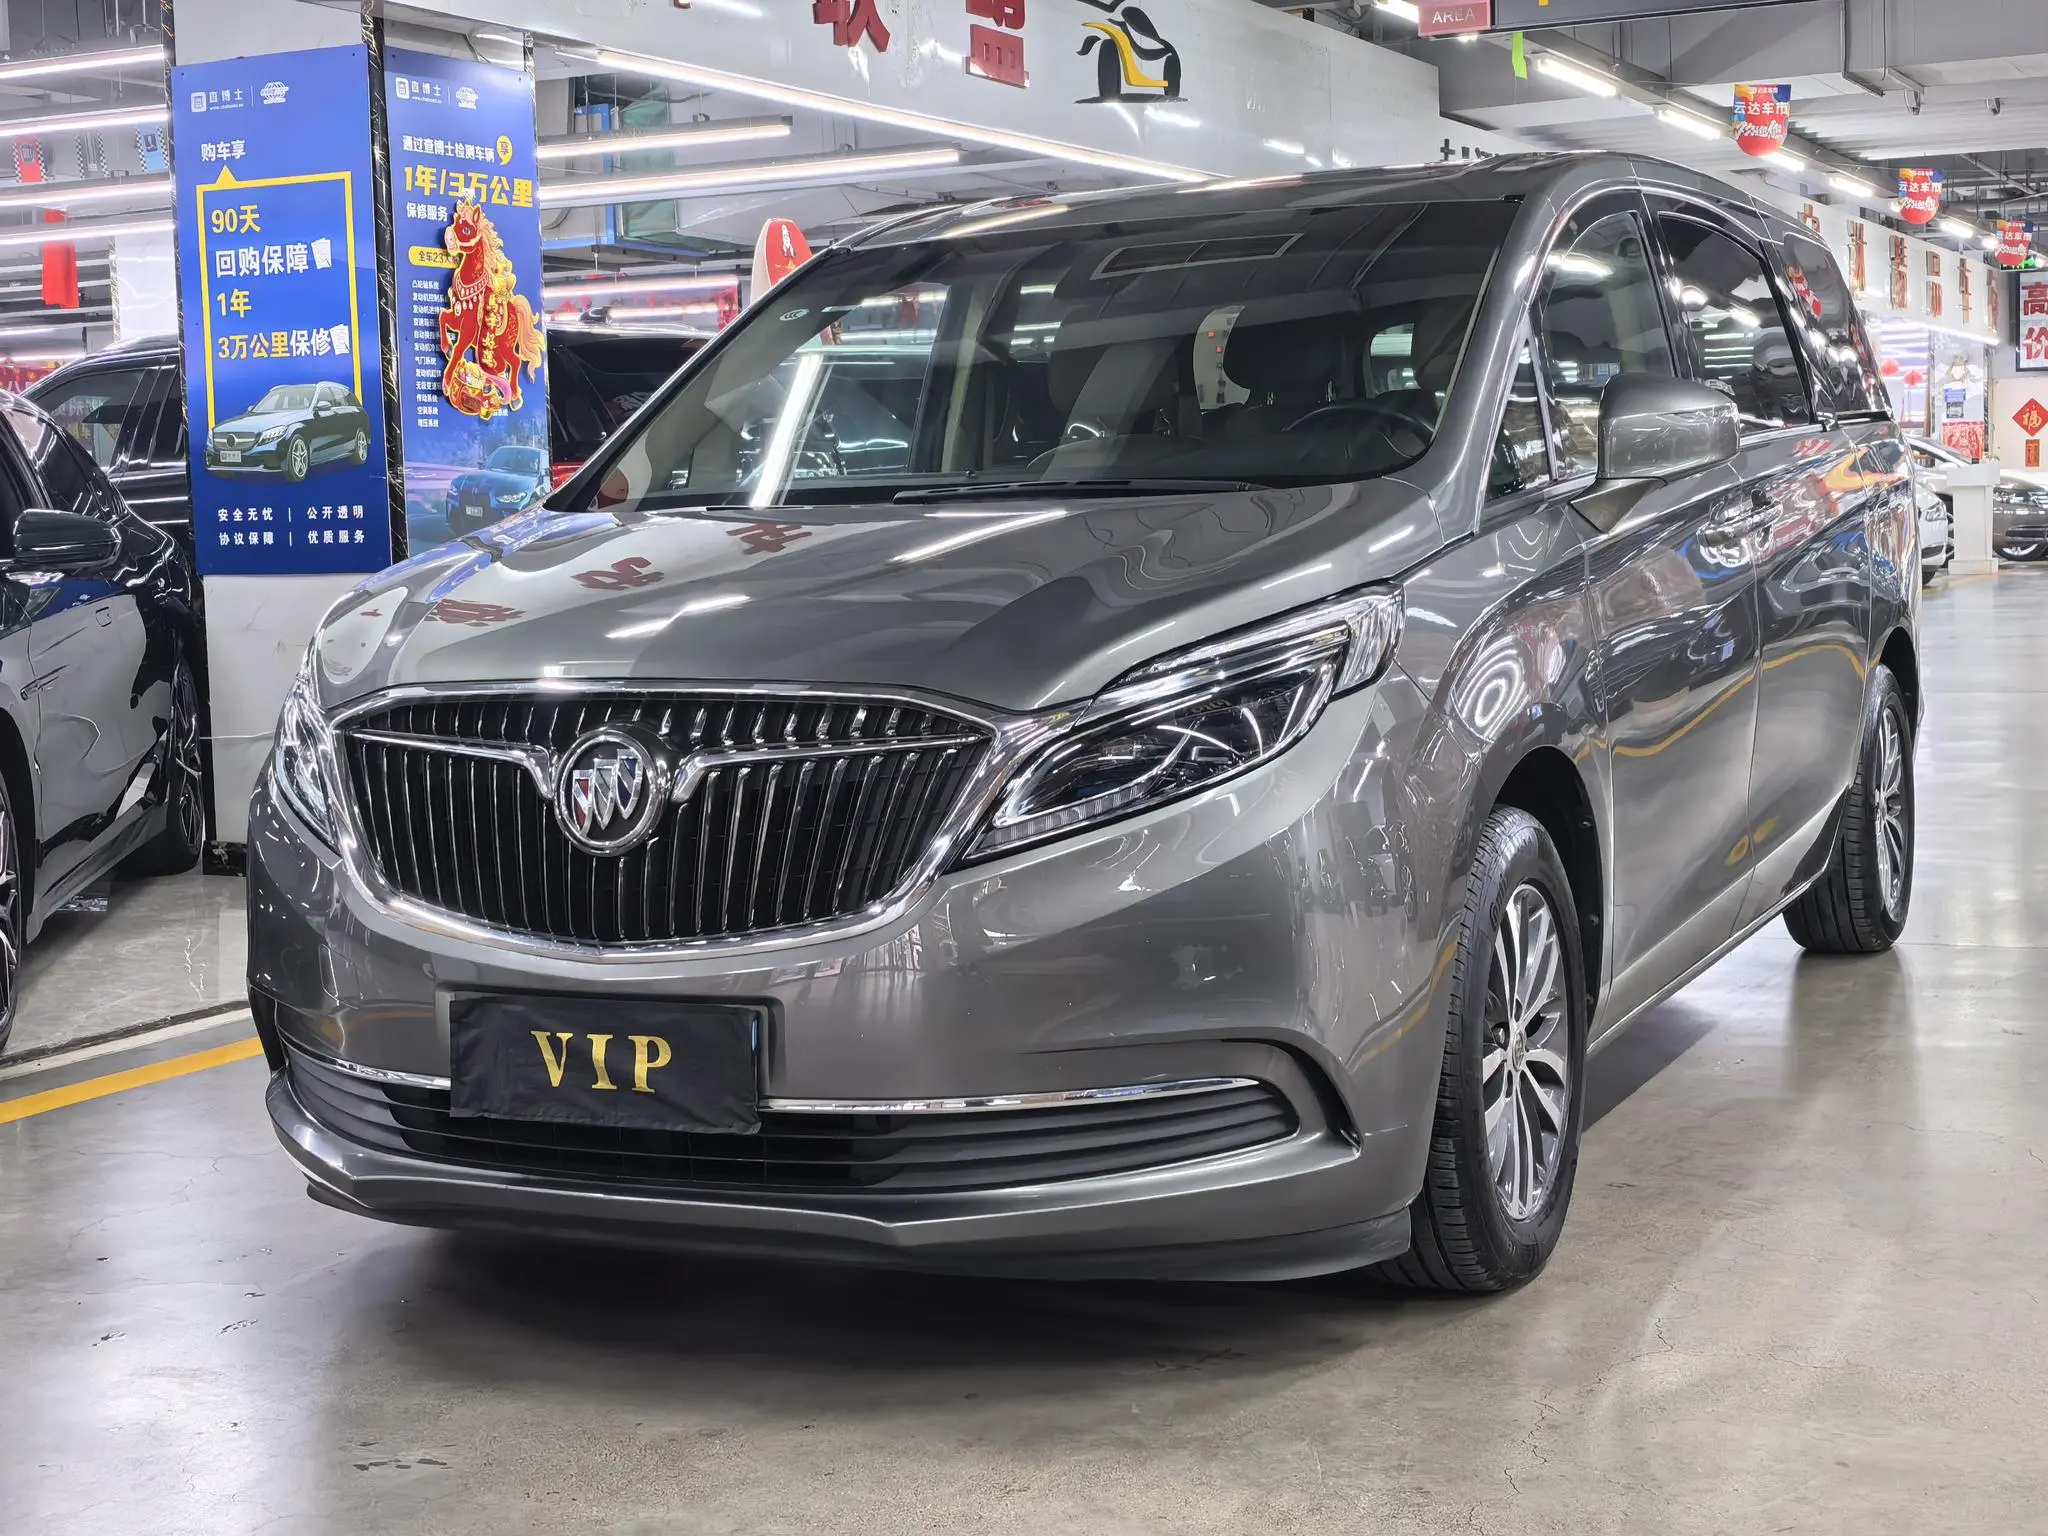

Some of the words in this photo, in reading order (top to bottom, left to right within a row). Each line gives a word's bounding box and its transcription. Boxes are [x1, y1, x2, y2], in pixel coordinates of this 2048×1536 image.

[1432, 8, 1475, 24] AREA
[1734, 101, 1790, 117] 云达车市
[201, 139, 246, 162] 购车享
[402, 135, 495, 162] 通过查博士检测车辆
[404, 164, 533, 208] 1年/3万公里
[211, 204, 262, 234] 90天
[406, 201, 448, 222] 保修服务
[215, 242, 308, 278] 回购保障
[217, 288, 252, 318] 1年
[218, 329, 332, 360] 3万公里保修
[2022, 404, 2042, 429] 福
[217, 507, 274, 521] 安全无忧
[307, 505, 364, 519] 公开透明
[219, 531, 274, 546] 协议保障
[308, 529, 365, 544] 优质服务
[530, 1030, 672, 1093] VIP
